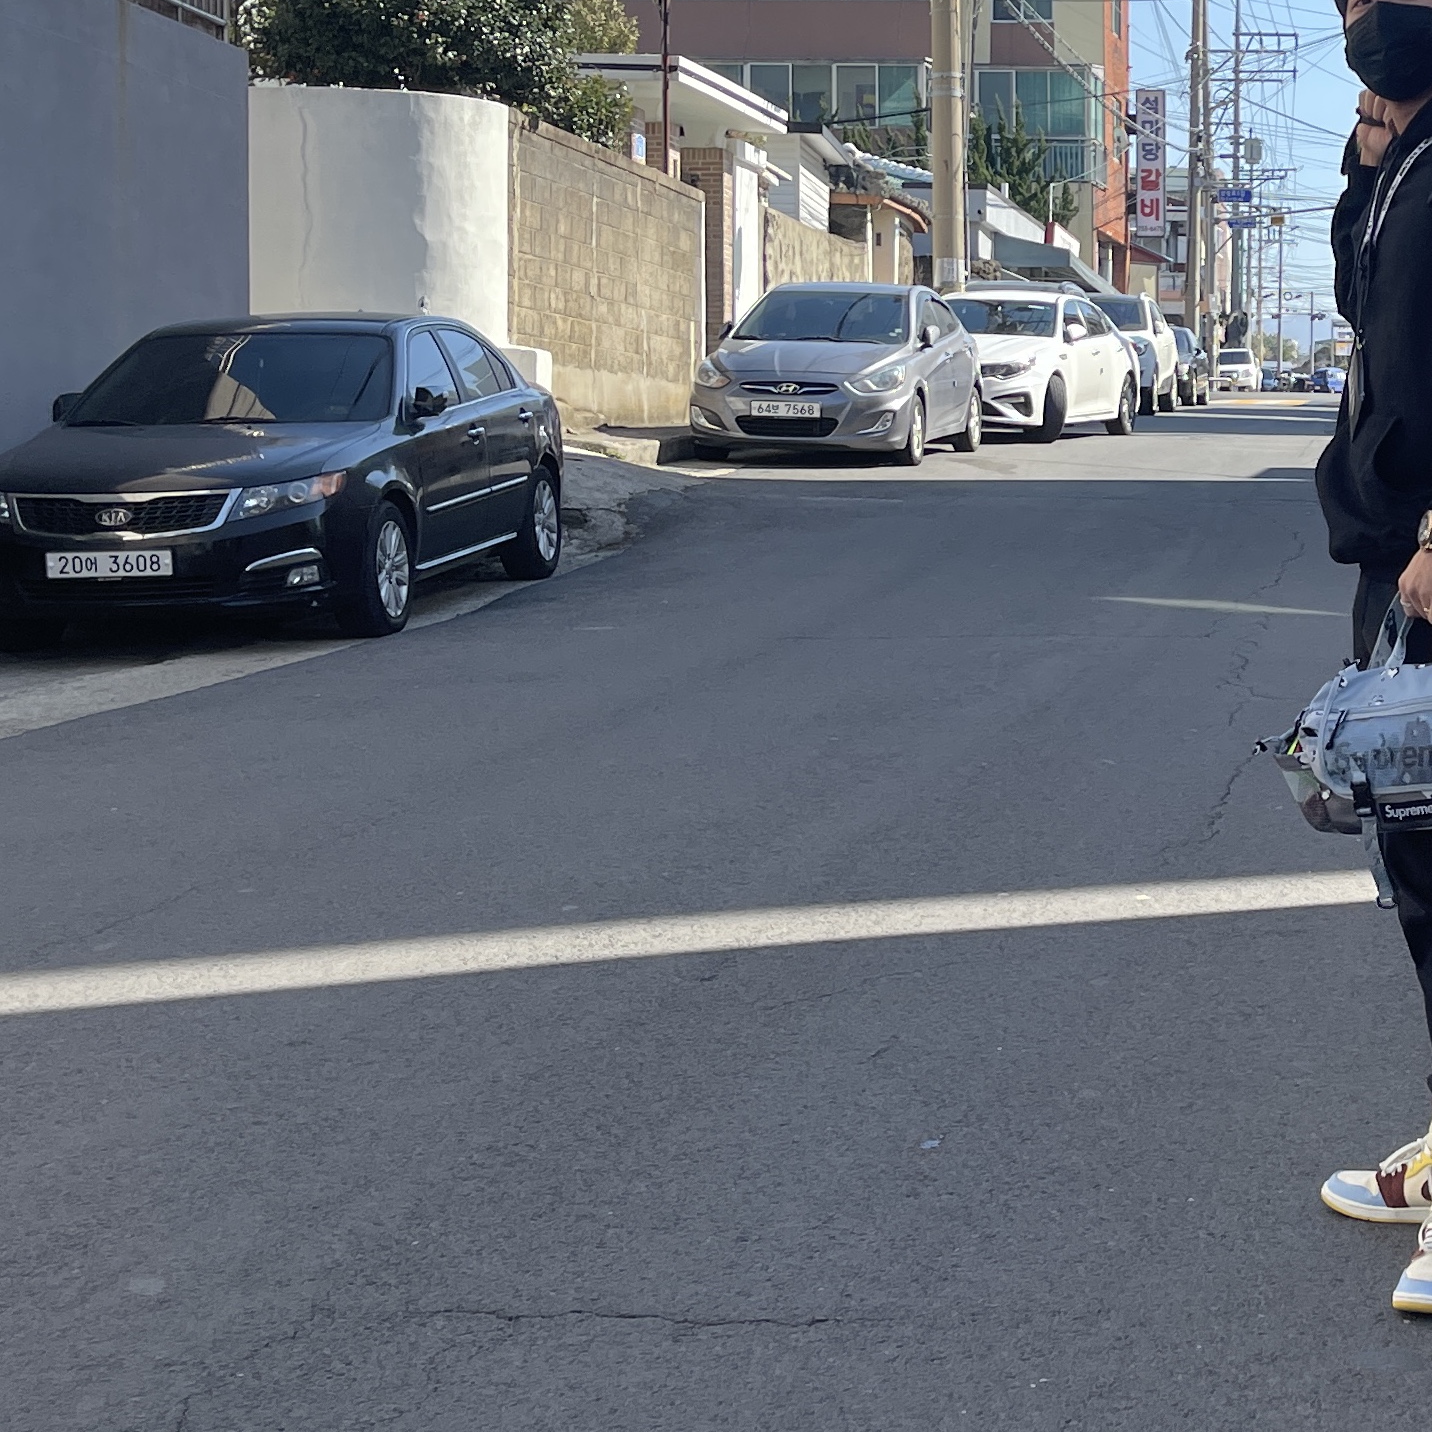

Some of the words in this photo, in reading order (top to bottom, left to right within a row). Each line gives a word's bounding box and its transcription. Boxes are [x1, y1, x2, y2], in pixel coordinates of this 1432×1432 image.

[1140, 168, 1162, 221] 갈비
[784, 403, 815, 416] 7568
[101, 509, 126, 525] KIA
[109, 554, 161, 574] 3608
